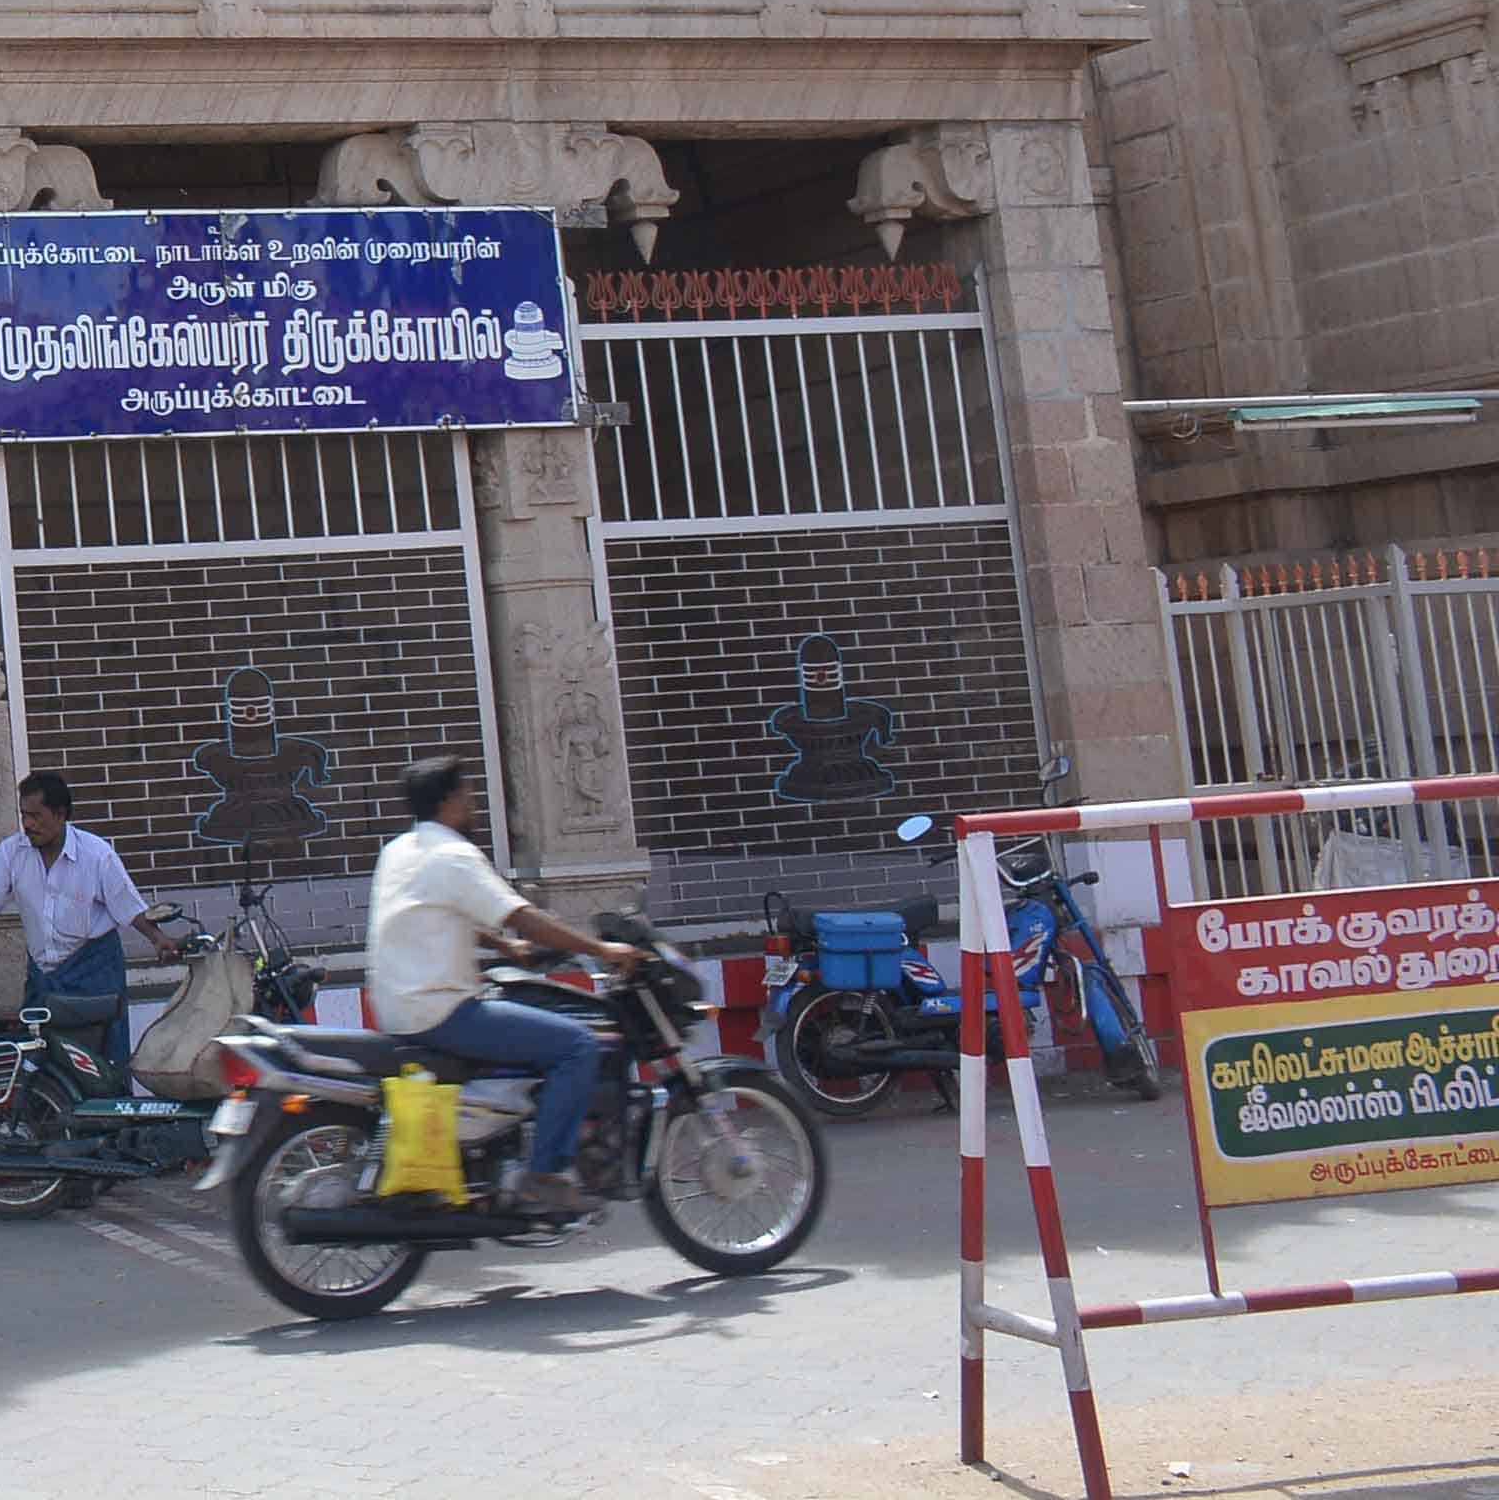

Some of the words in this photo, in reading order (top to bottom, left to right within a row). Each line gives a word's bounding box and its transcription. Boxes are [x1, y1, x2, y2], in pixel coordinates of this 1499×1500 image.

[155, 239, 261, 268] நாடார்கள்
[268, 236, 360, 268] உறவின்
[365, 234, 501, 266] முறையாரின்
[166, 273, 255, 306] அருள்
[264, 272, 317, 301] மிகு
[282, 308, 502, 376] திருக்கோயில்
[121, 382, 366, 416] அருப்புக்கோட்டை
